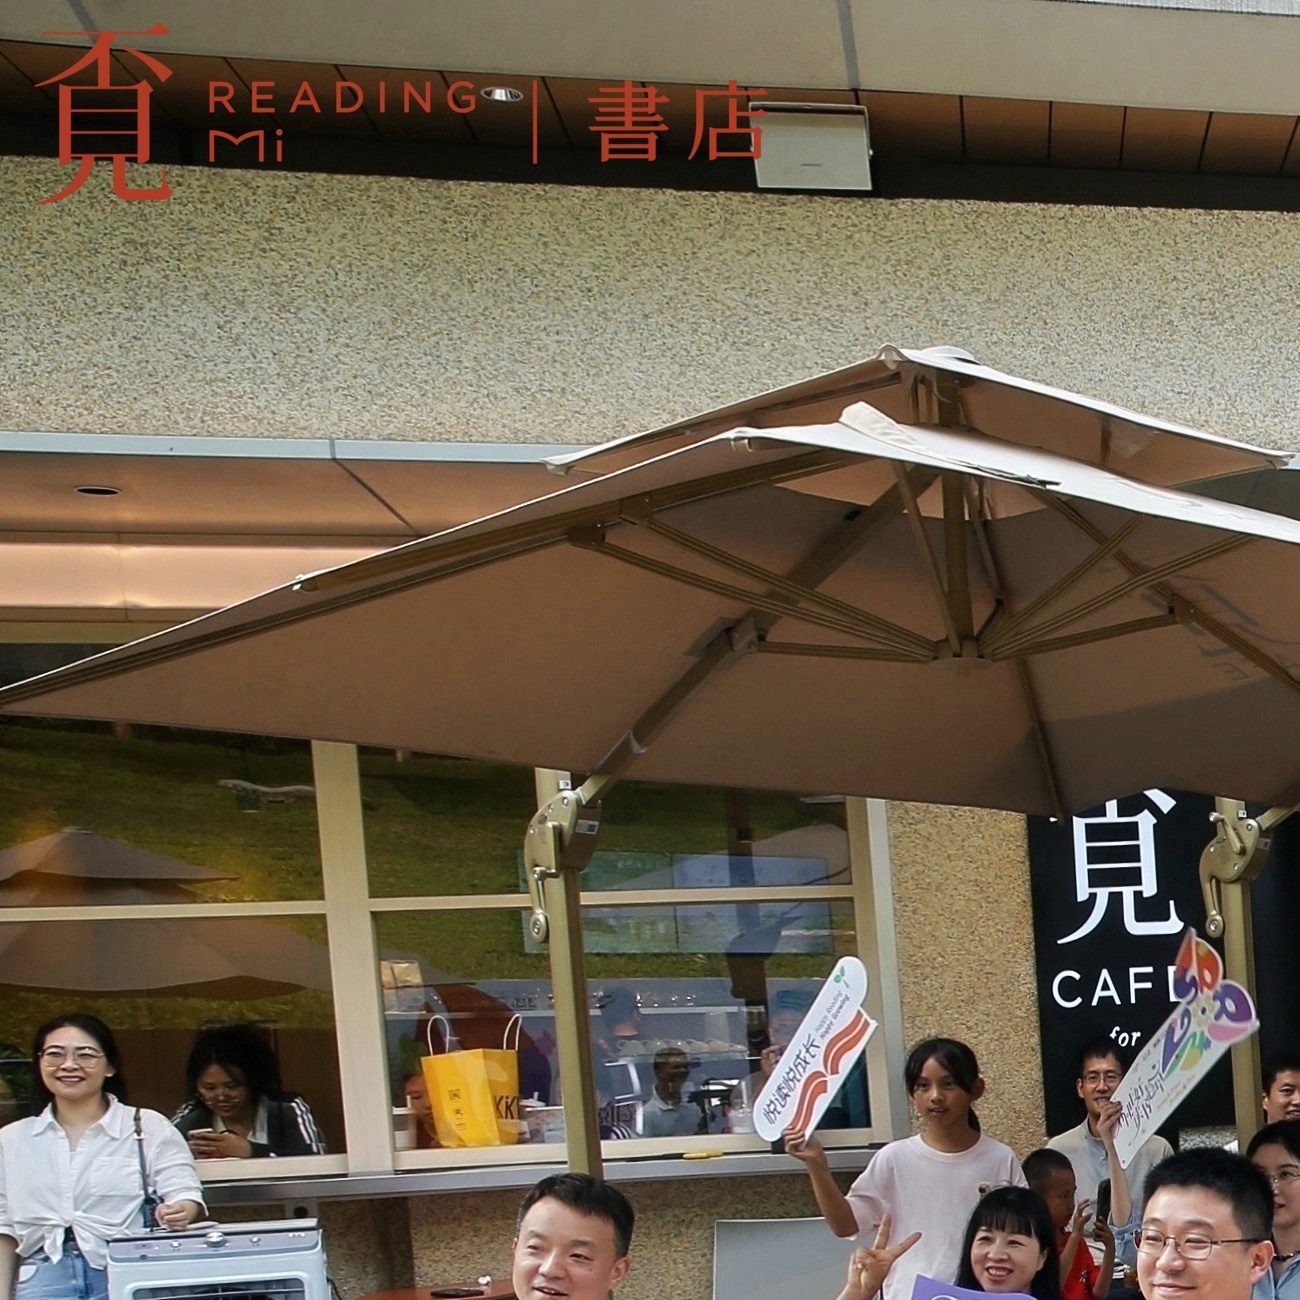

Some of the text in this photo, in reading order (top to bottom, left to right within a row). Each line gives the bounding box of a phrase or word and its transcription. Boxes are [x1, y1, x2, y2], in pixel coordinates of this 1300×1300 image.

[1109, 1025, 1142, 1047] for
[762, 1033, 822, 1125] 悦读悦成长
